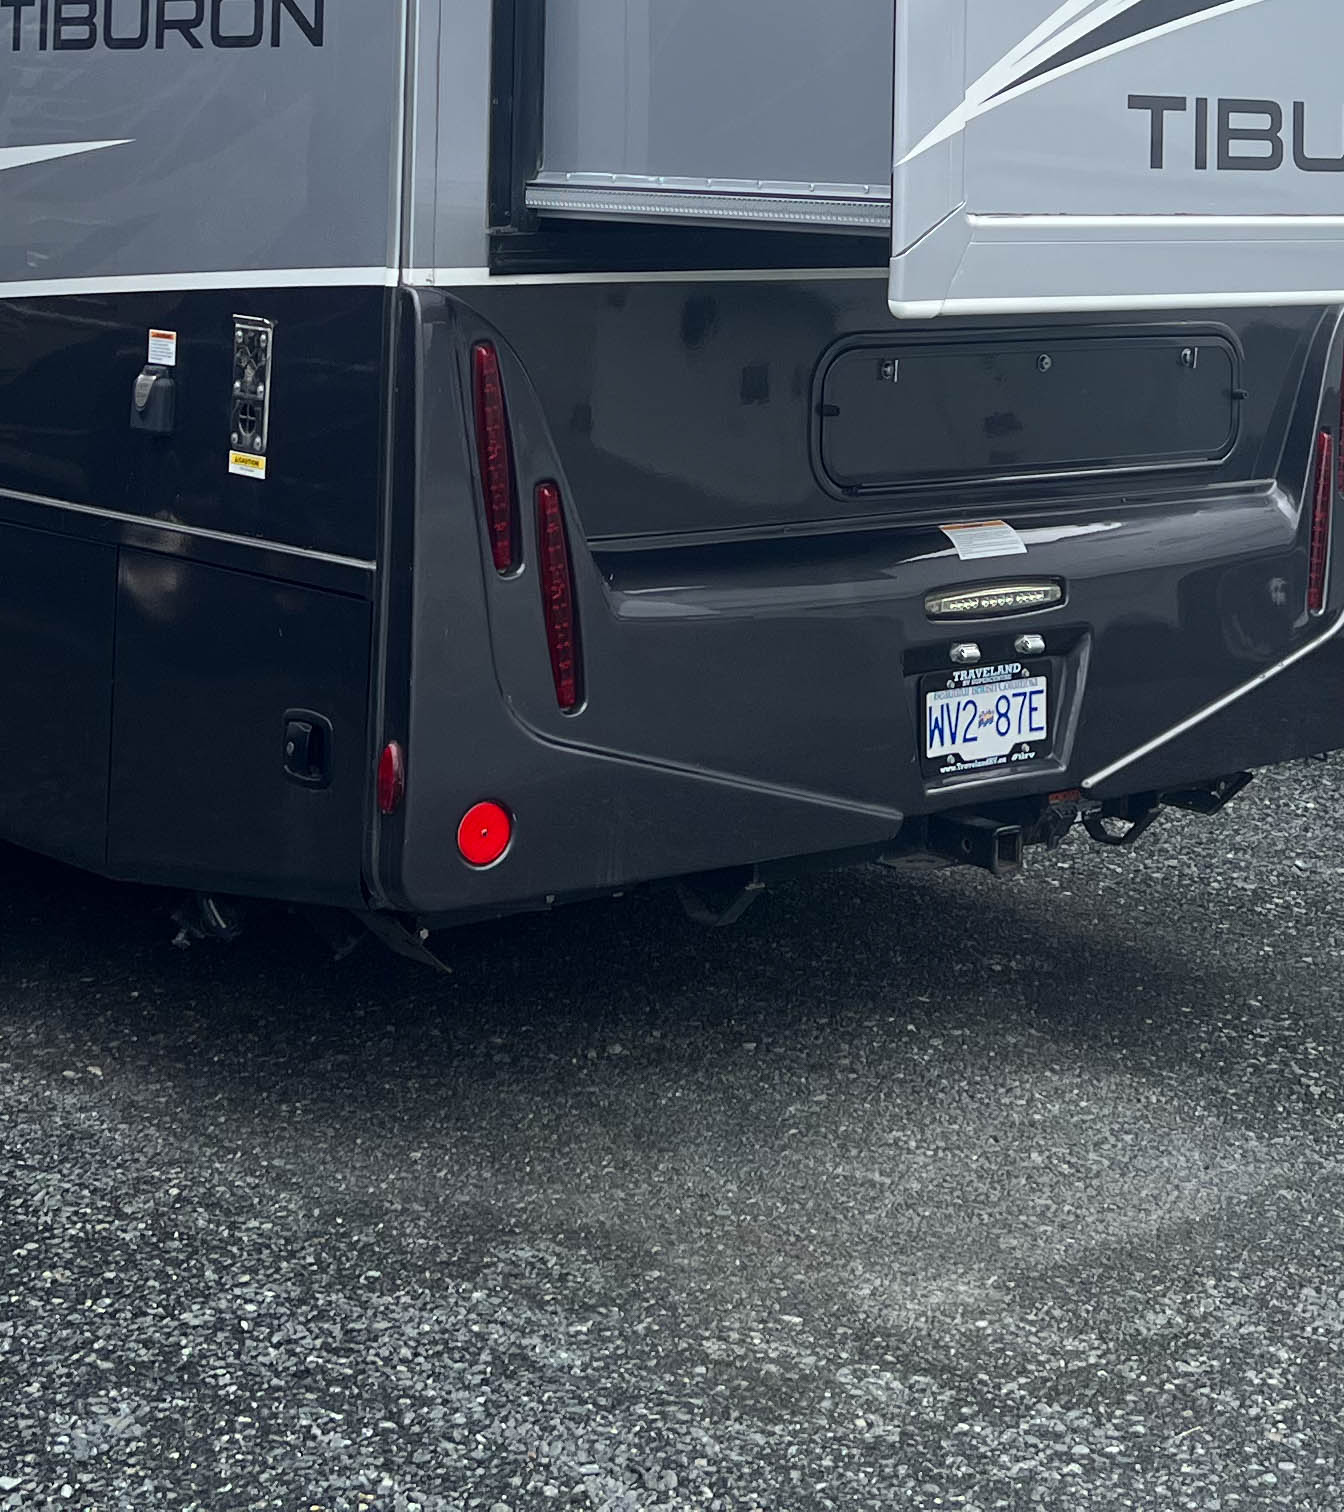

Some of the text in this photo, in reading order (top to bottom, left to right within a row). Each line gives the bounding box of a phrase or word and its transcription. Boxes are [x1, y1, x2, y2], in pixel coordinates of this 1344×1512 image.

[953, 663, 1021, 682] TRAVELAND
[928, 689, 1044, 750] WV2 87E
